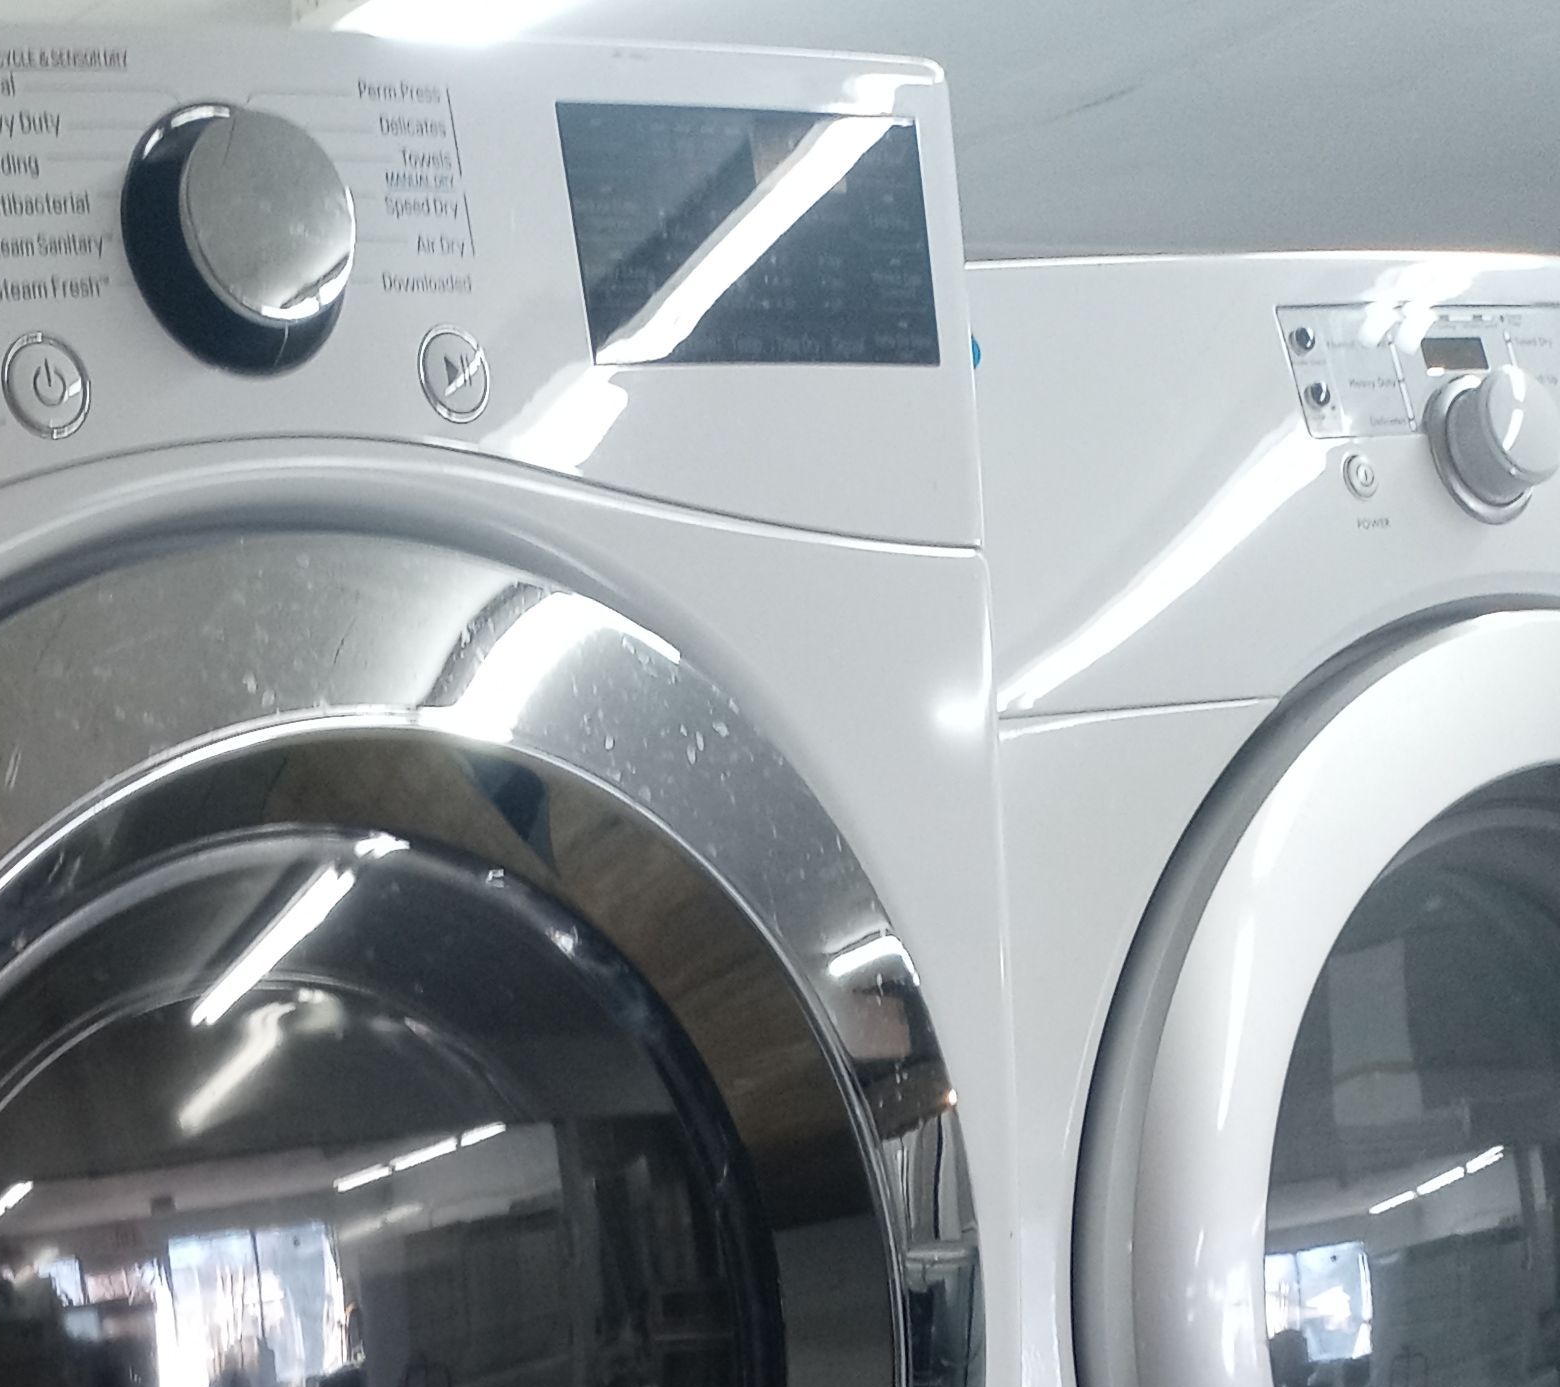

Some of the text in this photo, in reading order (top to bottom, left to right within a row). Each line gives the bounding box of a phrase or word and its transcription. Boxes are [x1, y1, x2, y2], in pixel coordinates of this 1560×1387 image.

[357, 79, 441, 104] Perm Press
[19, 110, 60, 138] Duty
[379, 114, 447, 138] Delicates
[402, 147, 452, 170] Towels
[385, 196, 458, 220] Speed Dry
[417, 234, 465, 258] Air Dry
[382, 272, 472, 294] Downloaded
[1357, 517, 1390, 530] POWER
